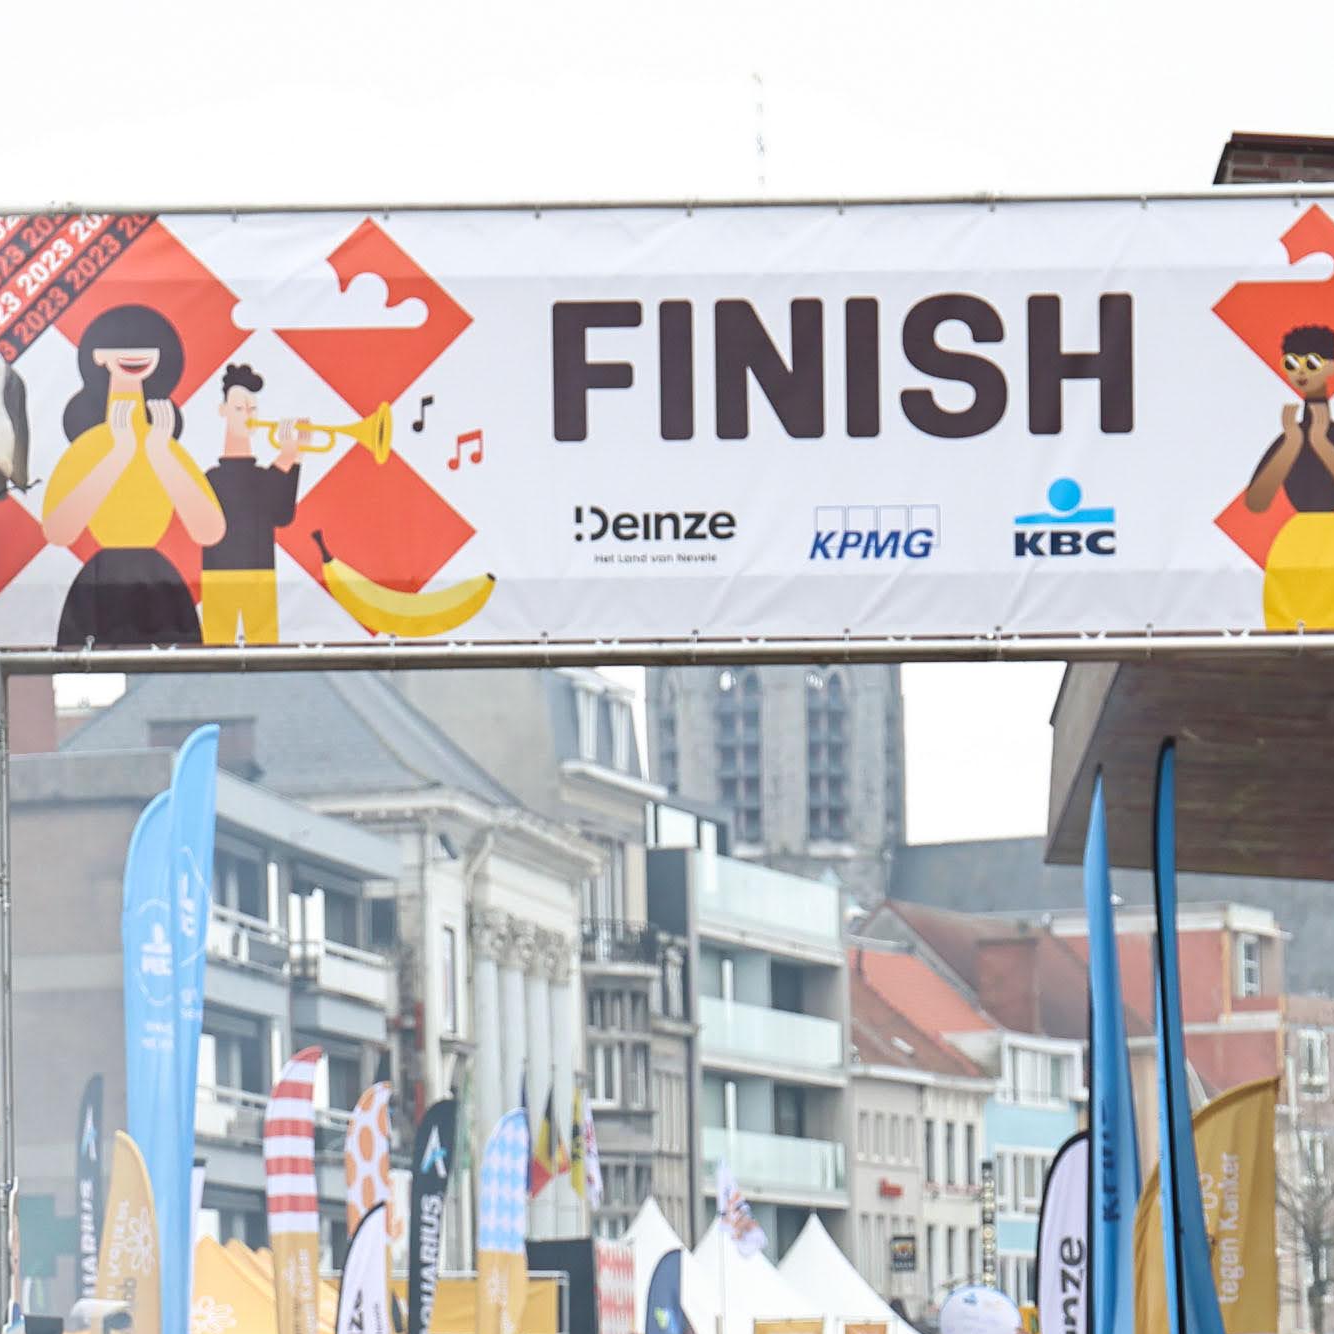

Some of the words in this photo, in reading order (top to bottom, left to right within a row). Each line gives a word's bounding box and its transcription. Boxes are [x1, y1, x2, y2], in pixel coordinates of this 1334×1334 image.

[13, 286, 69, 345] 2023
[64, 233, 122, 291] 2023
[17, 238, 74, 297] 2023
[553, 292, 1134, 441] FINISH
[593, 553, 614, 564] Het
[619, 552, 648, 564] Land
[652, 553, 674, 563] van
[676, 552, 718, 563] Nevele
[809, 527, 935, 561] KPMG
[1014, 529, 1116, 558] KBC
[1217, 1152, 1240, 1231] Kanker
[1219, 1240, 1245, 1304] tegen
